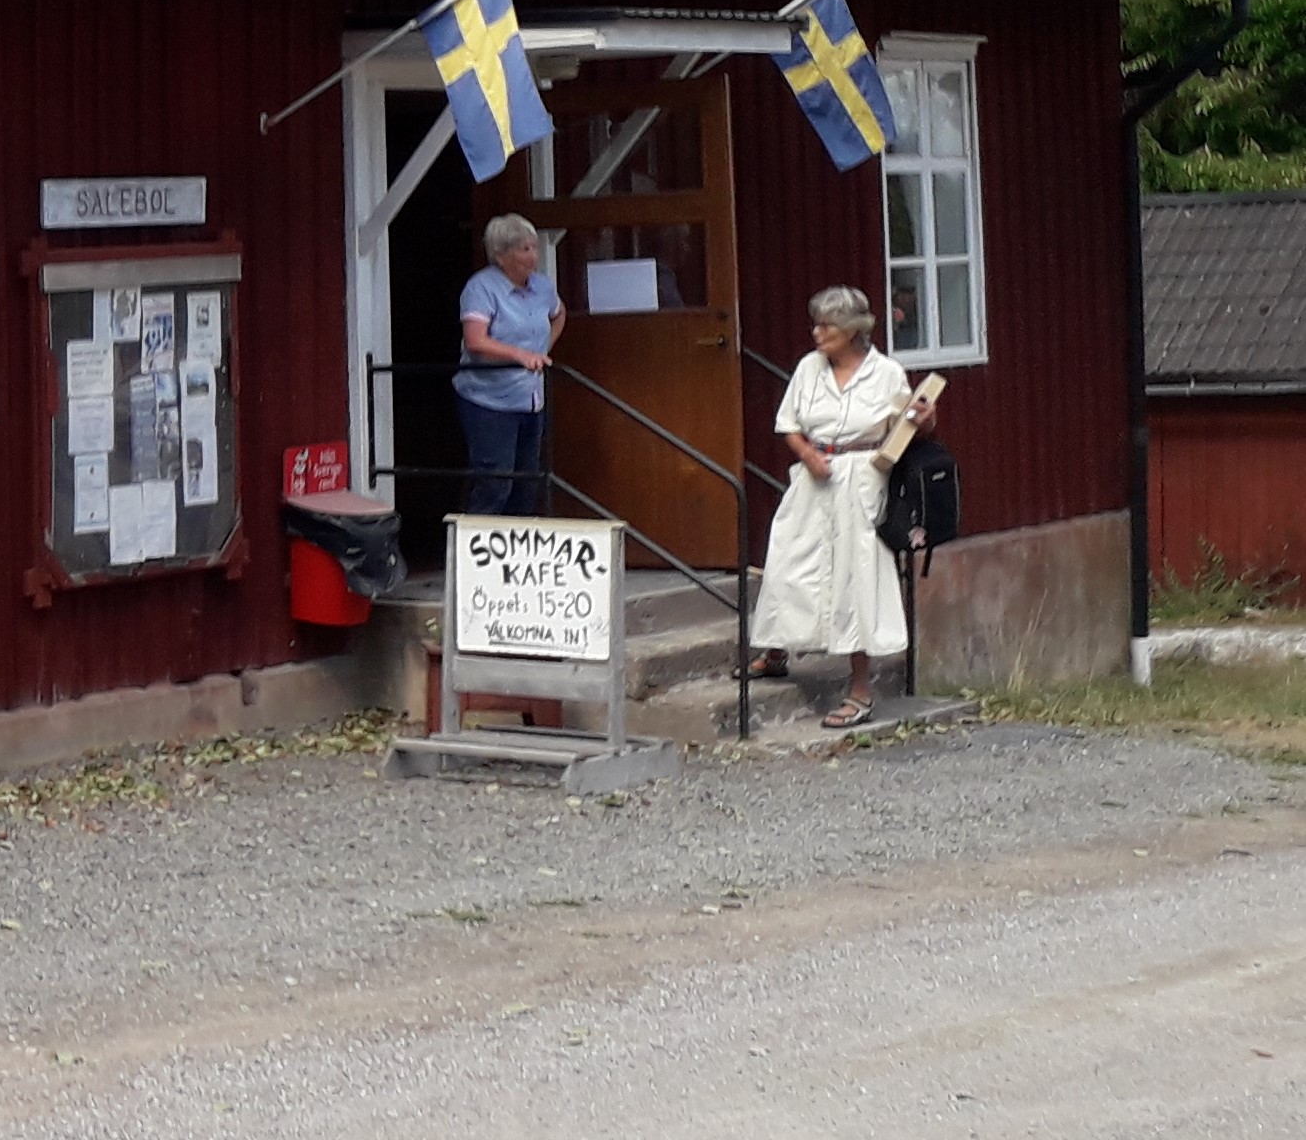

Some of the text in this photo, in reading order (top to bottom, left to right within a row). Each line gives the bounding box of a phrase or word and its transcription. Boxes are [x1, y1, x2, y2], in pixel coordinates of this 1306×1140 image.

[76, 186, 176, 218] SALEBOL
[469, 527, 607, 581] SOMMAR-
[537, 590, 593, 619] 15-20
[563, 625, 589, 648] IN!
